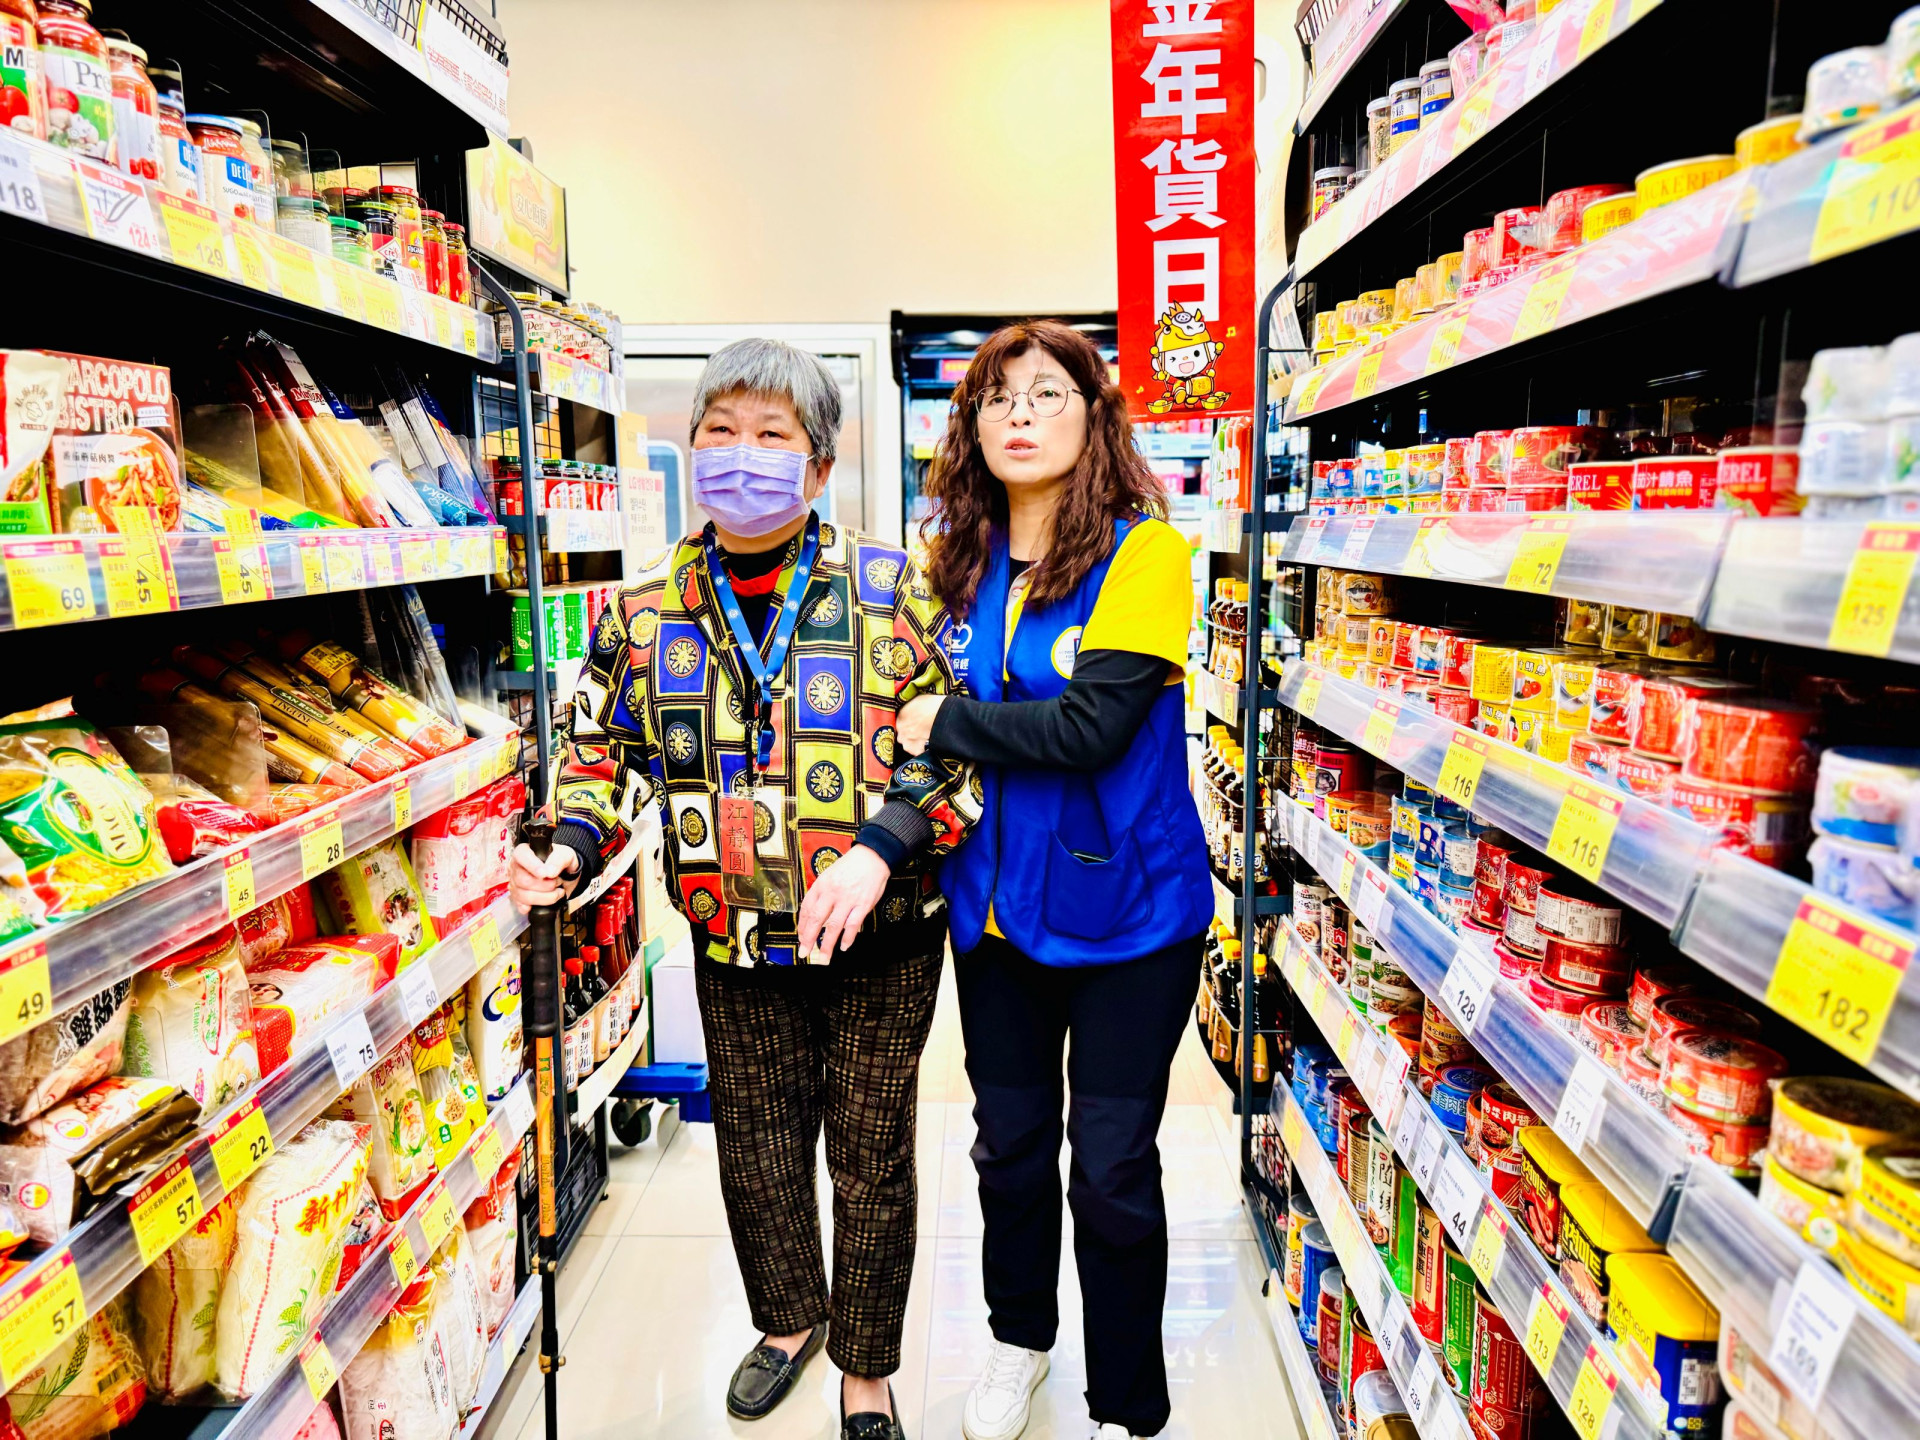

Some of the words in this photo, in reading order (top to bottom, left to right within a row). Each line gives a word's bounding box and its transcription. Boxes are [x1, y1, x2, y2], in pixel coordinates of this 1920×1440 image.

[196, 242, 224, 268] 129
[56, 394, 135, 435] BISTRO
[239, 563, 253, 595] 45
[313, 572, 323, 584] 54
[421, 560, 433, 575] 45
[1533, 562, 1552, 585] 72
[61, 587, 86, 611] 69
[136, 569, 153, 604] 45
[1851, 602, 1886, 627] 125
[1453, 774, 1472, 799] 116
[326, 843, 341, 863] 28
[1572, 835, 1600, 869] 116
[238, 888, 249, 902] 45
[488, 936, 499, 953] 21
[17, 991, 45, 1022] 49
[425, 990, 437, 1008] 60
[1457, 988, 1476, 1022] 128
[1817, 988, 1871, 1042] 182
[358, 1043, 374, 1065] 75
[1563, 1110, 1581, 1136] 111
[249, 1134, 269, 1162] 22
[492, 1147, 503, 1165] 39
[1420, 1166, 1429, 1179] 44
[176, 1194, 196, 1226] 57
[443, 1206, 455, 1226] 61
[1452, 1211, 1467, 1237] 44
[405, 1257, 414, 1272] 89
[1477, 1247, 1490, 1270] 113
[51, 1297, 77, 1335] 57
[1381, 1329, 1392, 1351] 248
[1533, 1332, 1549, 1360] 113
[319, 1369, 329, 1385] 34
[1410, 1387, 1421, 1412] 238
[1577, 1398, 1596, 1429] 128
